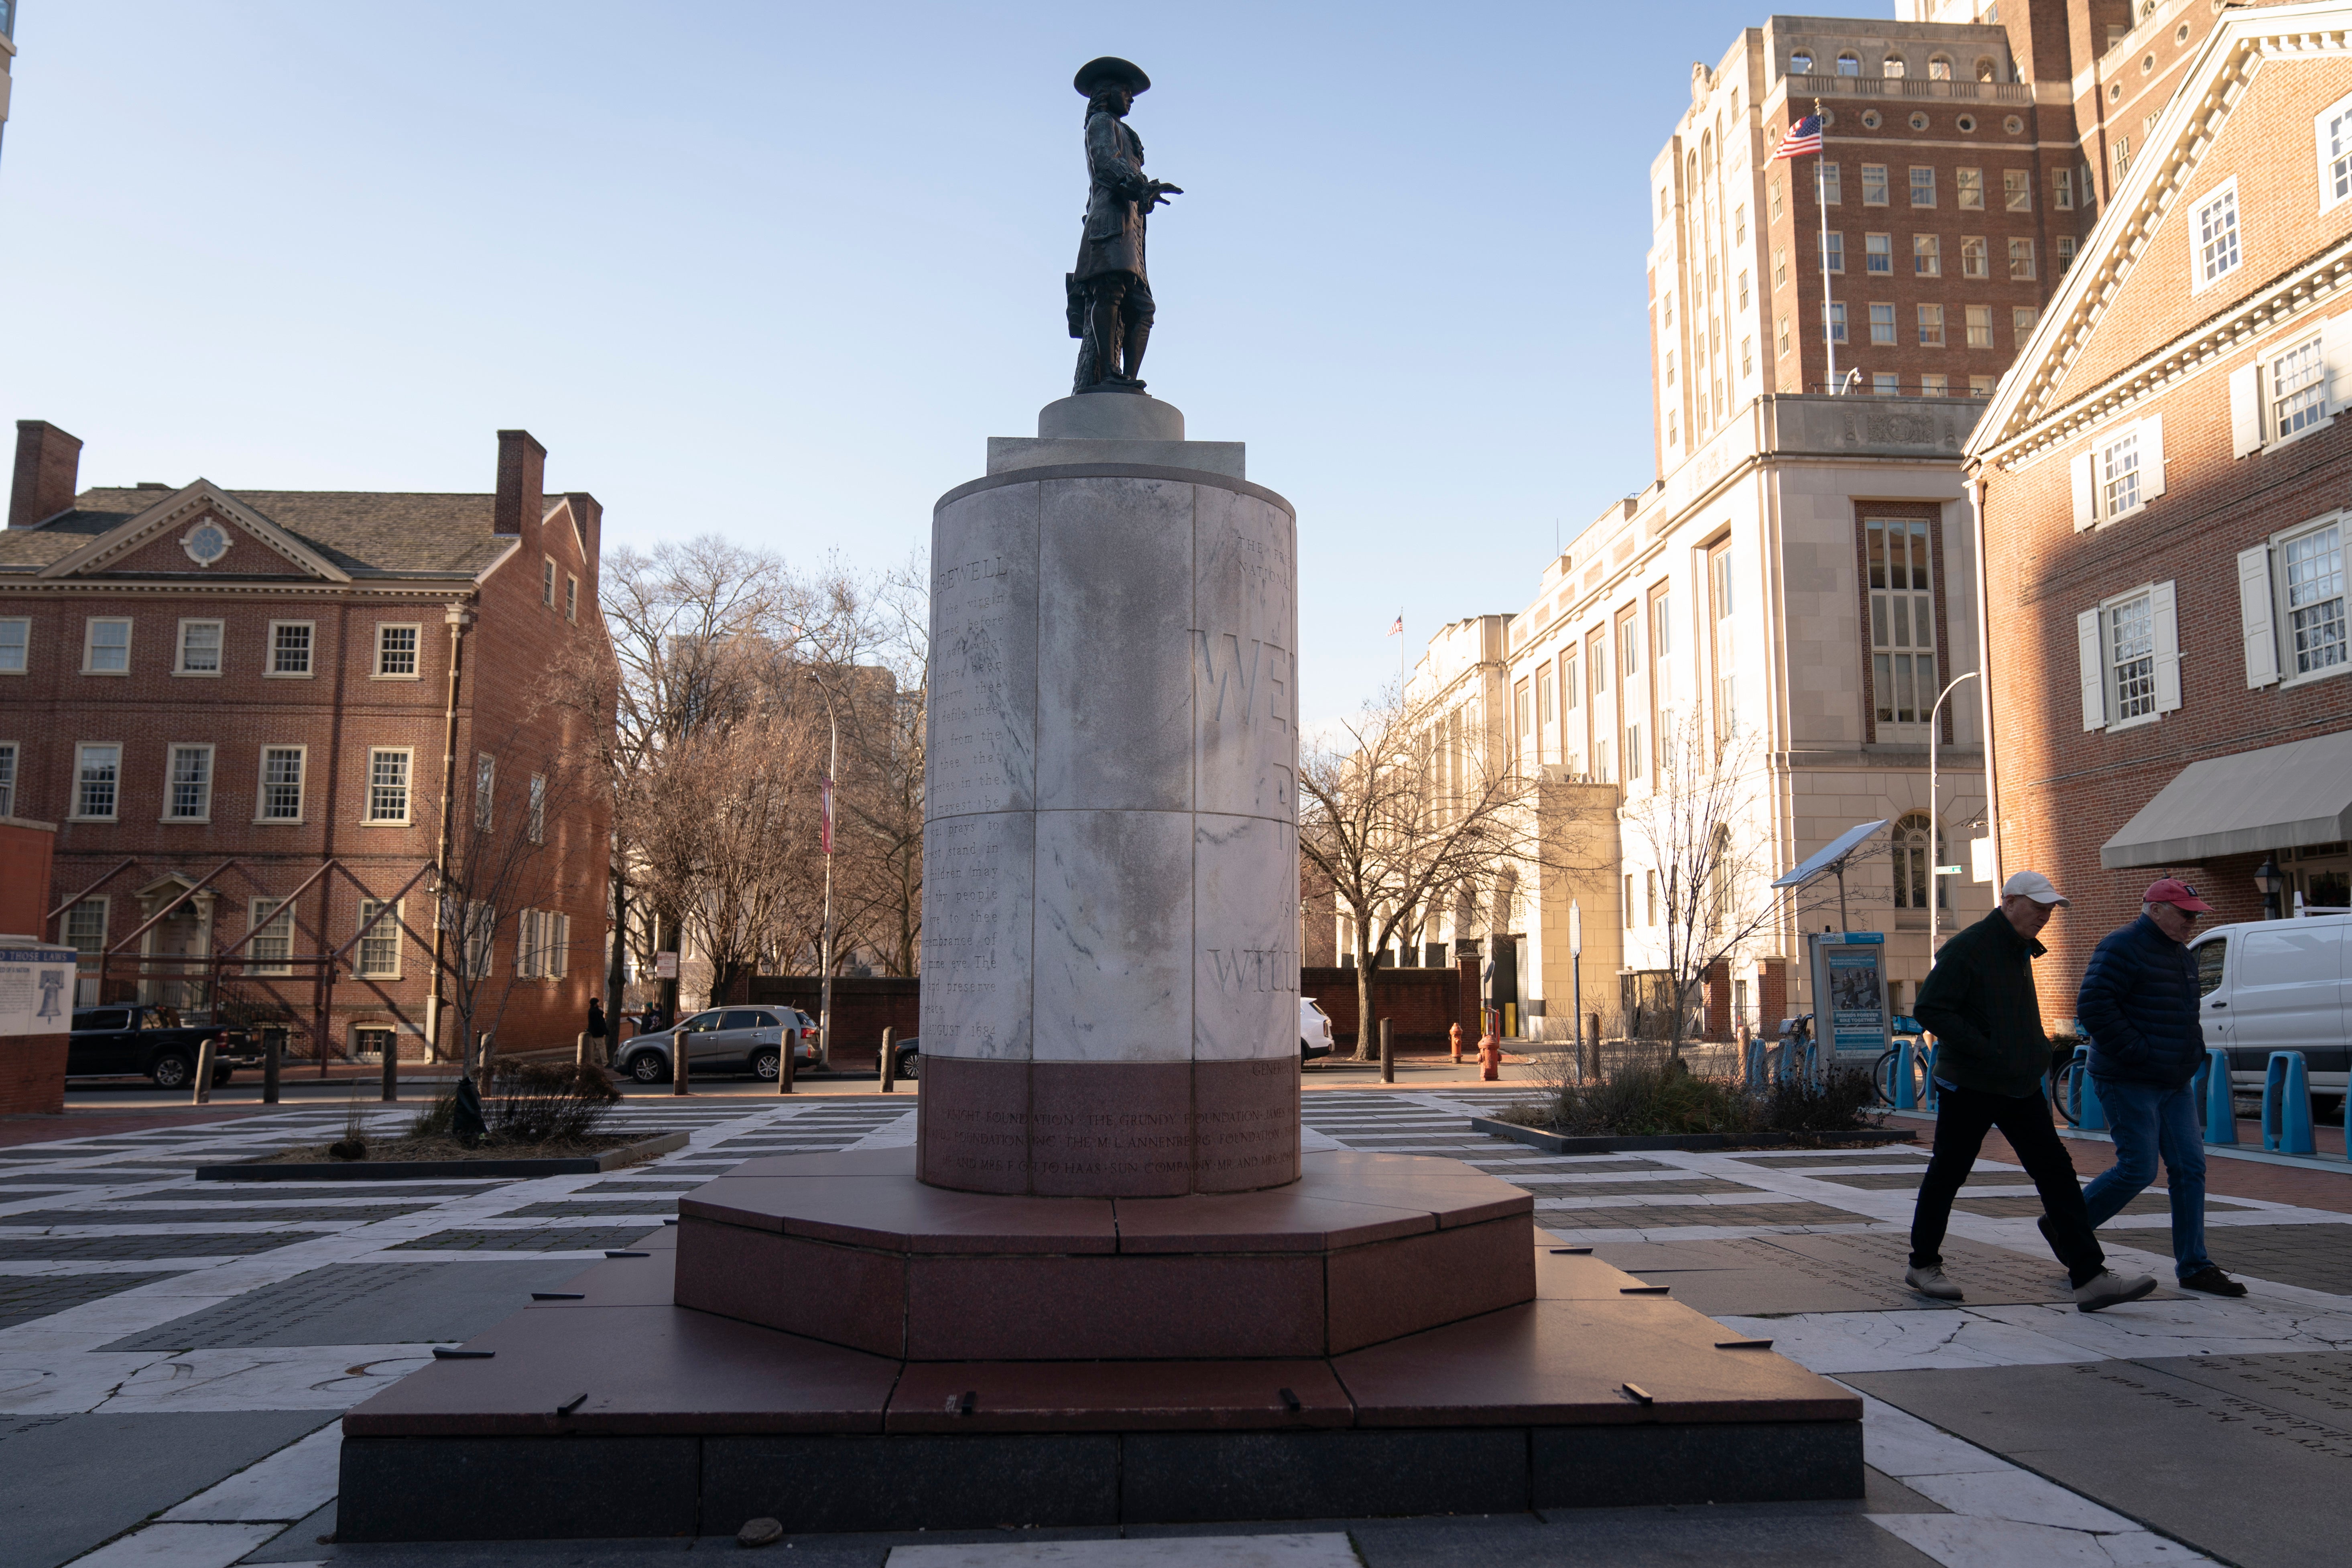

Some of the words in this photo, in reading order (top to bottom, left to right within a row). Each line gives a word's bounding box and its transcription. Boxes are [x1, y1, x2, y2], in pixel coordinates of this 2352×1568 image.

[1238, 537, 1262, 554] THE
[1238, 561, 1291, 591] NATIONAL
[945, 603, 959, 616] the
[967, 593, 1004, 608] virgin
[937, 622, 959, 642] named
[968, 615, 1004, 630] before
[974, 637, 1003, 649] what
[972, 661, 1002, 673] been
[975, 681, 1002, 694] thee
[942, 707, 966, 723] defile
[951, 734, 973, 746] from
[981, 728, 1001, 741] the
[974, 751, 1002, 764] that
[961, 777, 971, 788] in
[980, 773, 1000, 786] the
[938, 800, 971, 815] mayest
[985, 795, 999, 808] be
[949, 824, 975, 837] prays
[988, 821, 999, 830] to
[949, 842, 976, 856] stand
[986, 842, 998, 854] in
[972, 868, 998, 879] may
[936, 890, 947, 904] thy
[956, 887, 998, 903] people
[950, 914, 959, 923] to
[971, 909, 998, 923] thee
[1280, 901, 1289, 918] IS
[985, 932, 998, 945] of
[10, 951, 39, 961] THOSE
[44, 952, 67, 961] LAWS
[929, 958, 944, 969] mine
[975, 956, 996, 969] The
[928, 979, 939, 991] and
[947, 983, 996, 994] preserve
[928, 1025, 960, 1036] AUGUST
[971, 1025, 996, 1037] 1684
[1252, 1062, 1294, 1076] GENEROUS
[986, 1111, 1073, 1125] FOUNDATION
[1086, 1114, 1113, 1125] THE
[1119, 1114, 1177, 1126] GRUNDY
[1185, 1109, 1259, 1125] FOUNDATION
[1065, 1136, 1090, 1148] THE
[1128, 1135, 1211, 1148] ANNENBERG
[1220, 1128, 1279, 1145] FOUNDATION
[957, 1157, 976, 1169] AND
[1065, 1162, 1101, 1174] HAAS
[1110, 1162, 1138, 1174] SUN
[1144, 1159, 1212, 1174] COMPANY
[1237, 1156, 1258, 1169] AND
[1862, 1292, 1903, 1307] Great
[2189, 1358, 2230, 1370] the
[2228, 1356, 2261, 1366] be
[2067, 1365, 2099, 1373] by
[2265, 1369, 2321, 1383] may
[2100, 1376, 2145, 1388] out
[2238, 1374, 2269, 1382] in
[2139, 1391, 2203, 1407] laid
[2208, 1411, 2244, 1422] be
[2252, 1426, 2285, 1436] to
